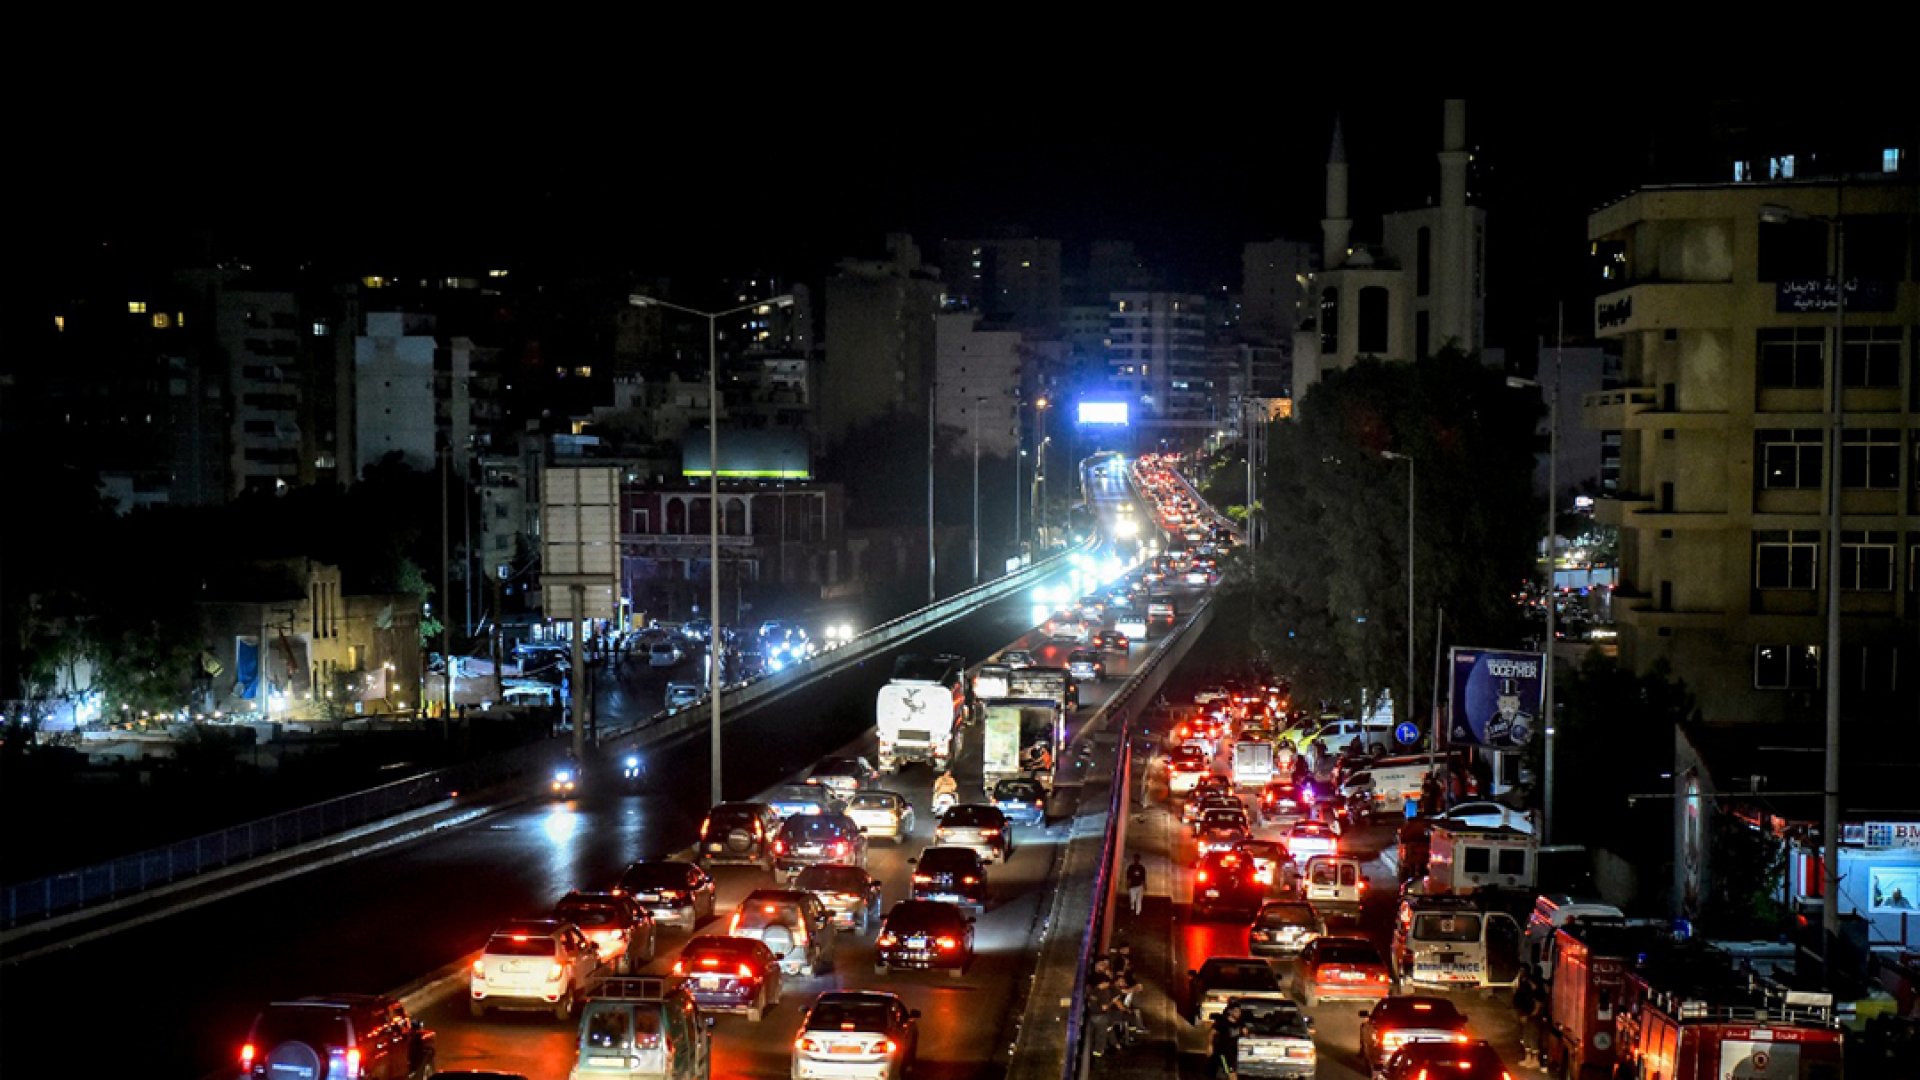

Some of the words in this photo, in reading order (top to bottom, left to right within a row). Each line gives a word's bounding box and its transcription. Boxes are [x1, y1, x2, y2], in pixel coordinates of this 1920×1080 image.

[1783, 279, 1819, 294] الايمان
[1824, 277, 1858, 294] ثاية
[1793, 295, 1848, 311] اموذجية
[1488, 665, 1537, 679] TOGETHER
[1417, 962, 1480, 972] LANCE
